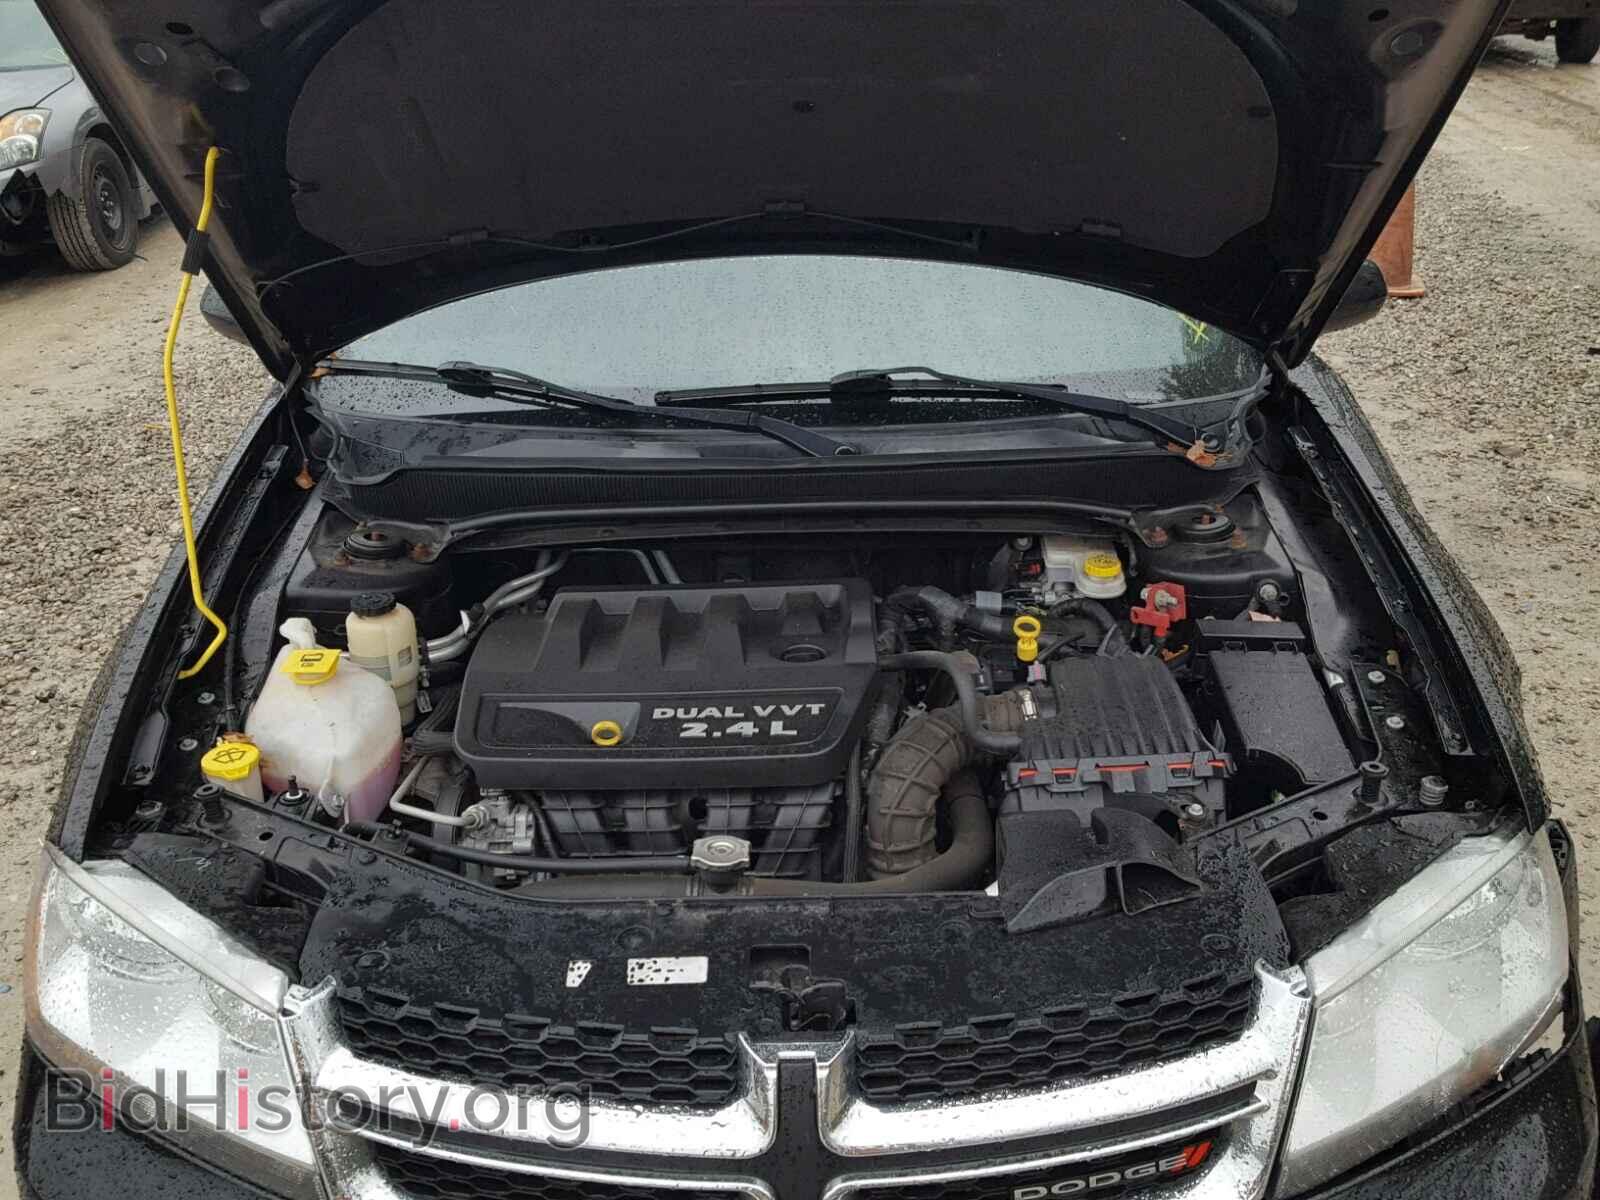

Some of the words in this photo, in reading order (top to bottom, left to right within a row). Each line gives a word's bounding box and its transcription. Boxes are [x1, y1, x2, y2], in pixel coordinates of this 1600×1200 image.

[652, 706, 745, 719] DUAL
[753, 703, 826, 717] VVT
[1012, 1152, 1188, 1200] DODGE
